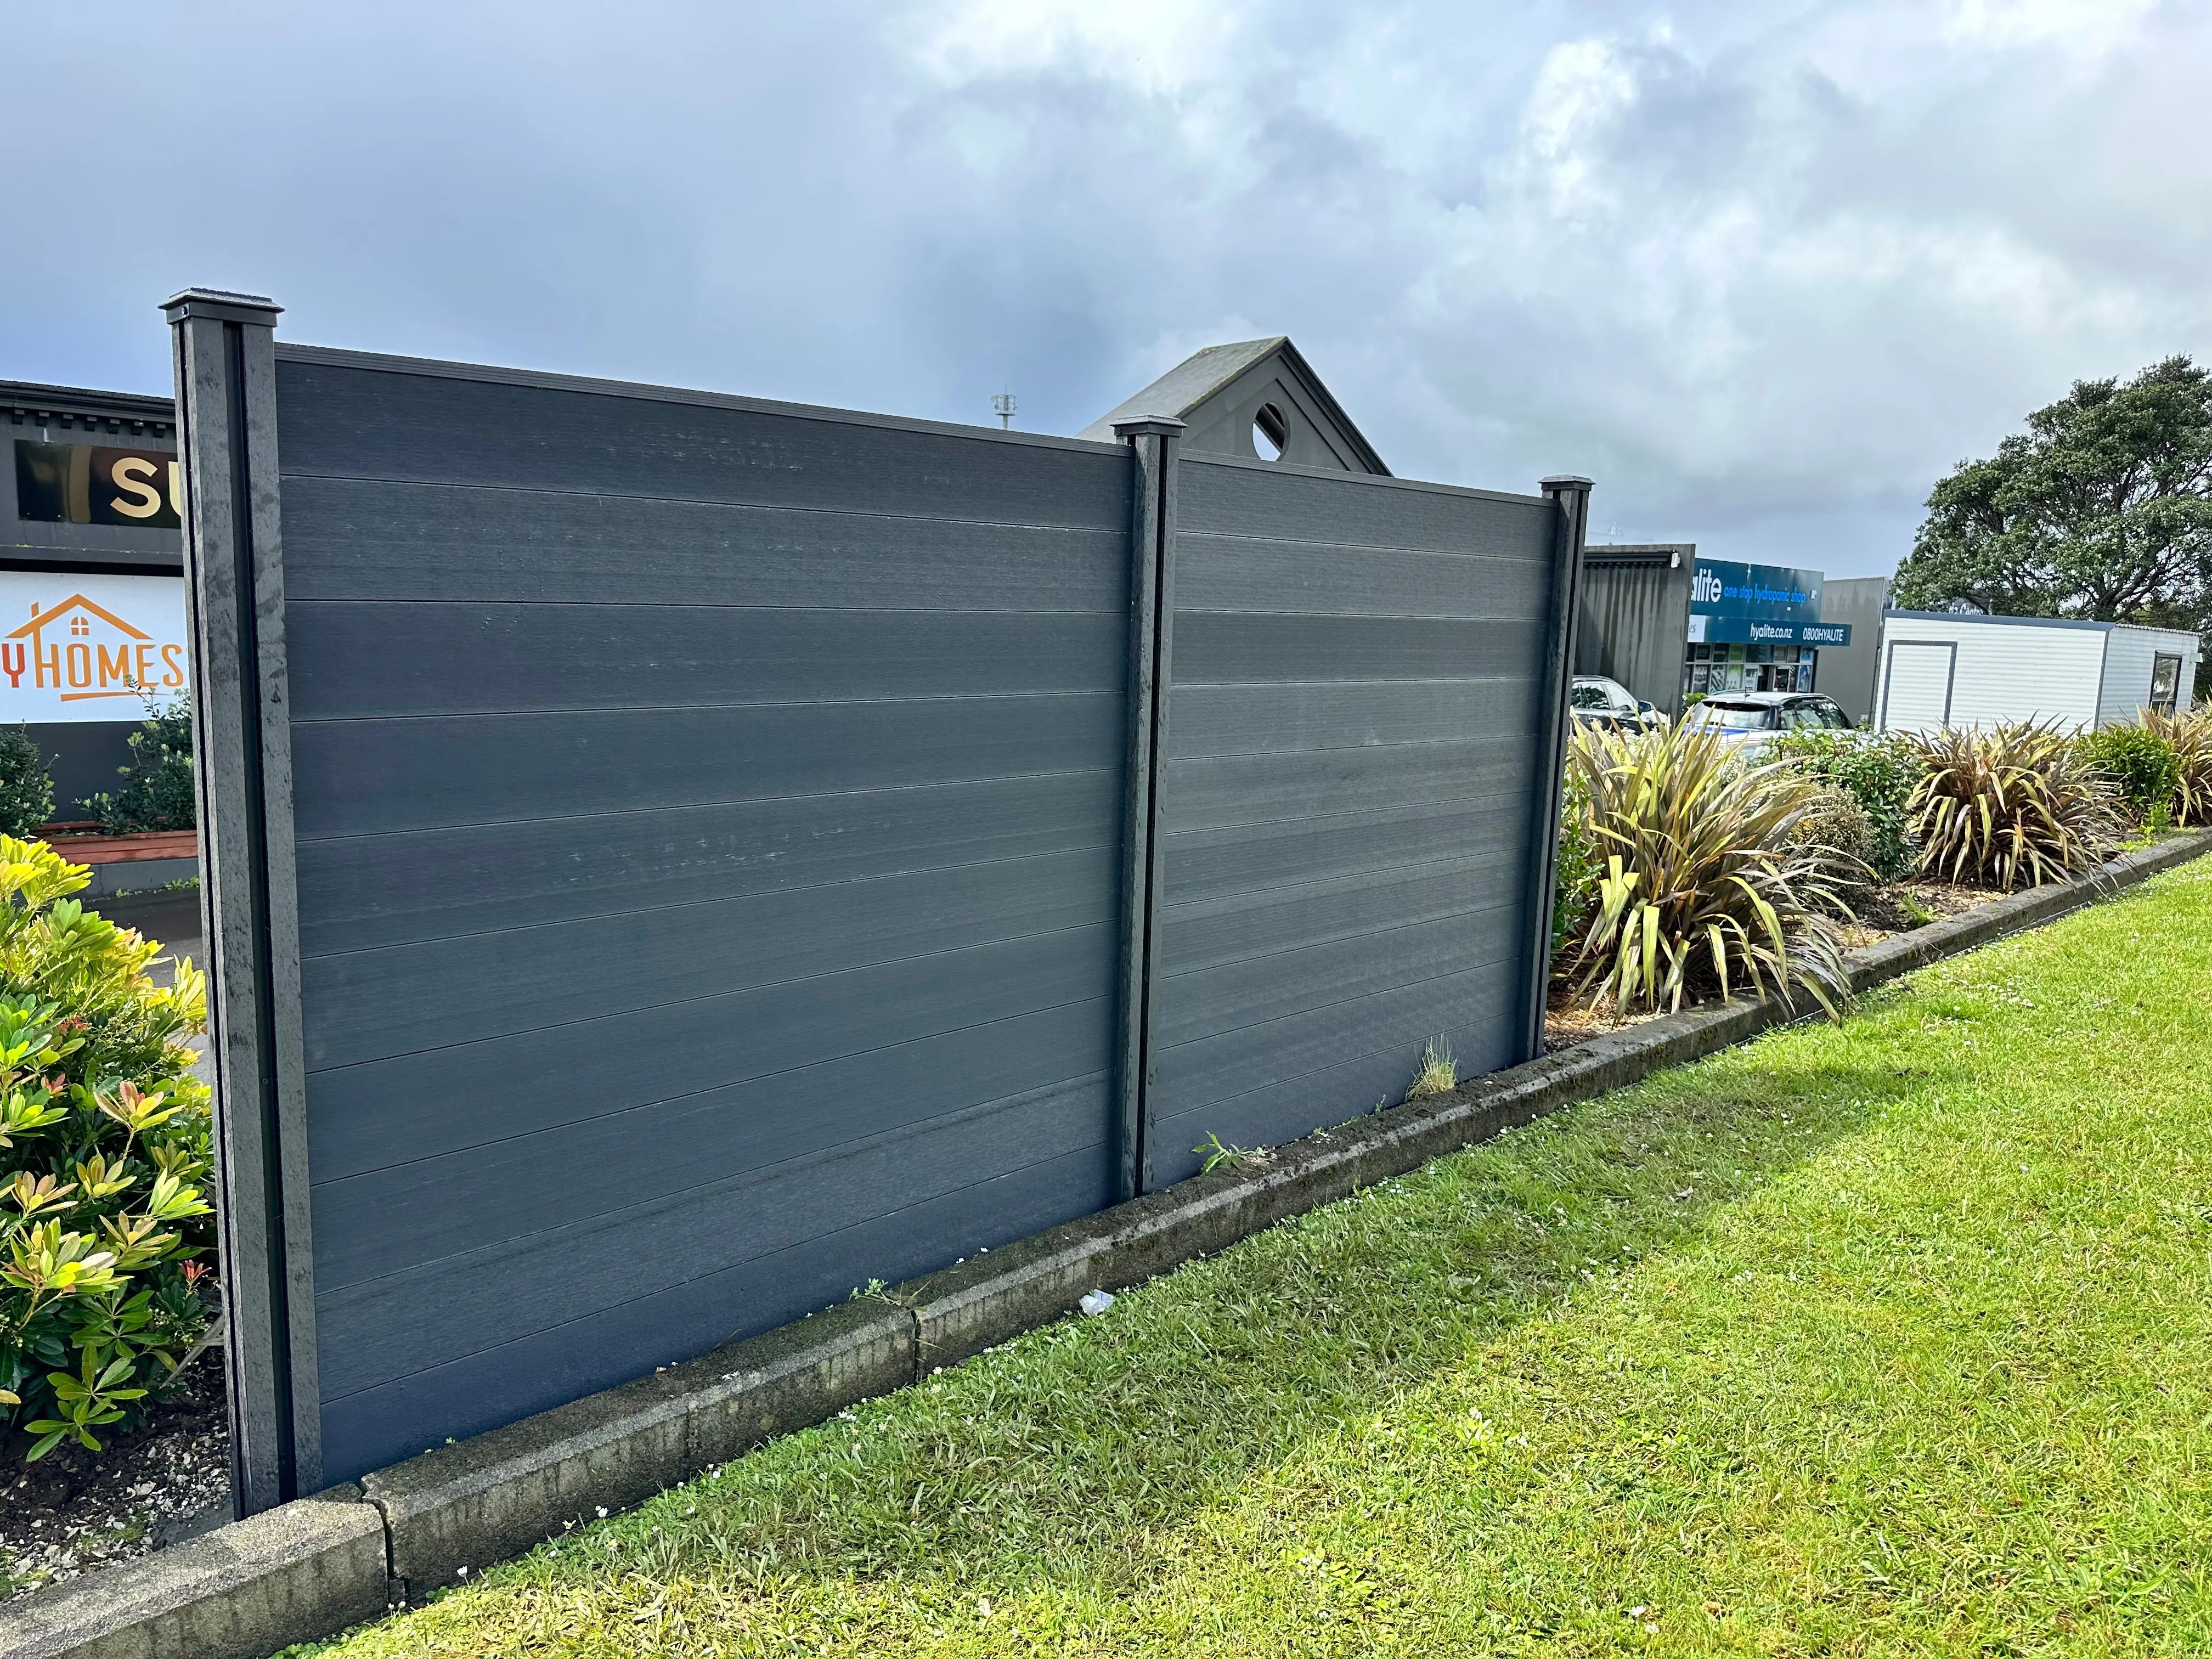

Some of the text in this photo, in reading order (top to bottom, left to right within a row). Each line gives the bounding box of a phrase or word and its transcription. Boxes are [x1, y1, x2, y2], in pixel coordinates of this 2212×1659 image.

[1724, 586, 1738, 598] one
[1739, 585, 1753, 603] stop
[1754, 583, 1790, 605] hydroponic
[1791, 586, 1806, 607] shop
[1750, 623, 1844, 641] hyalite.co.nz 0800HYALITE
